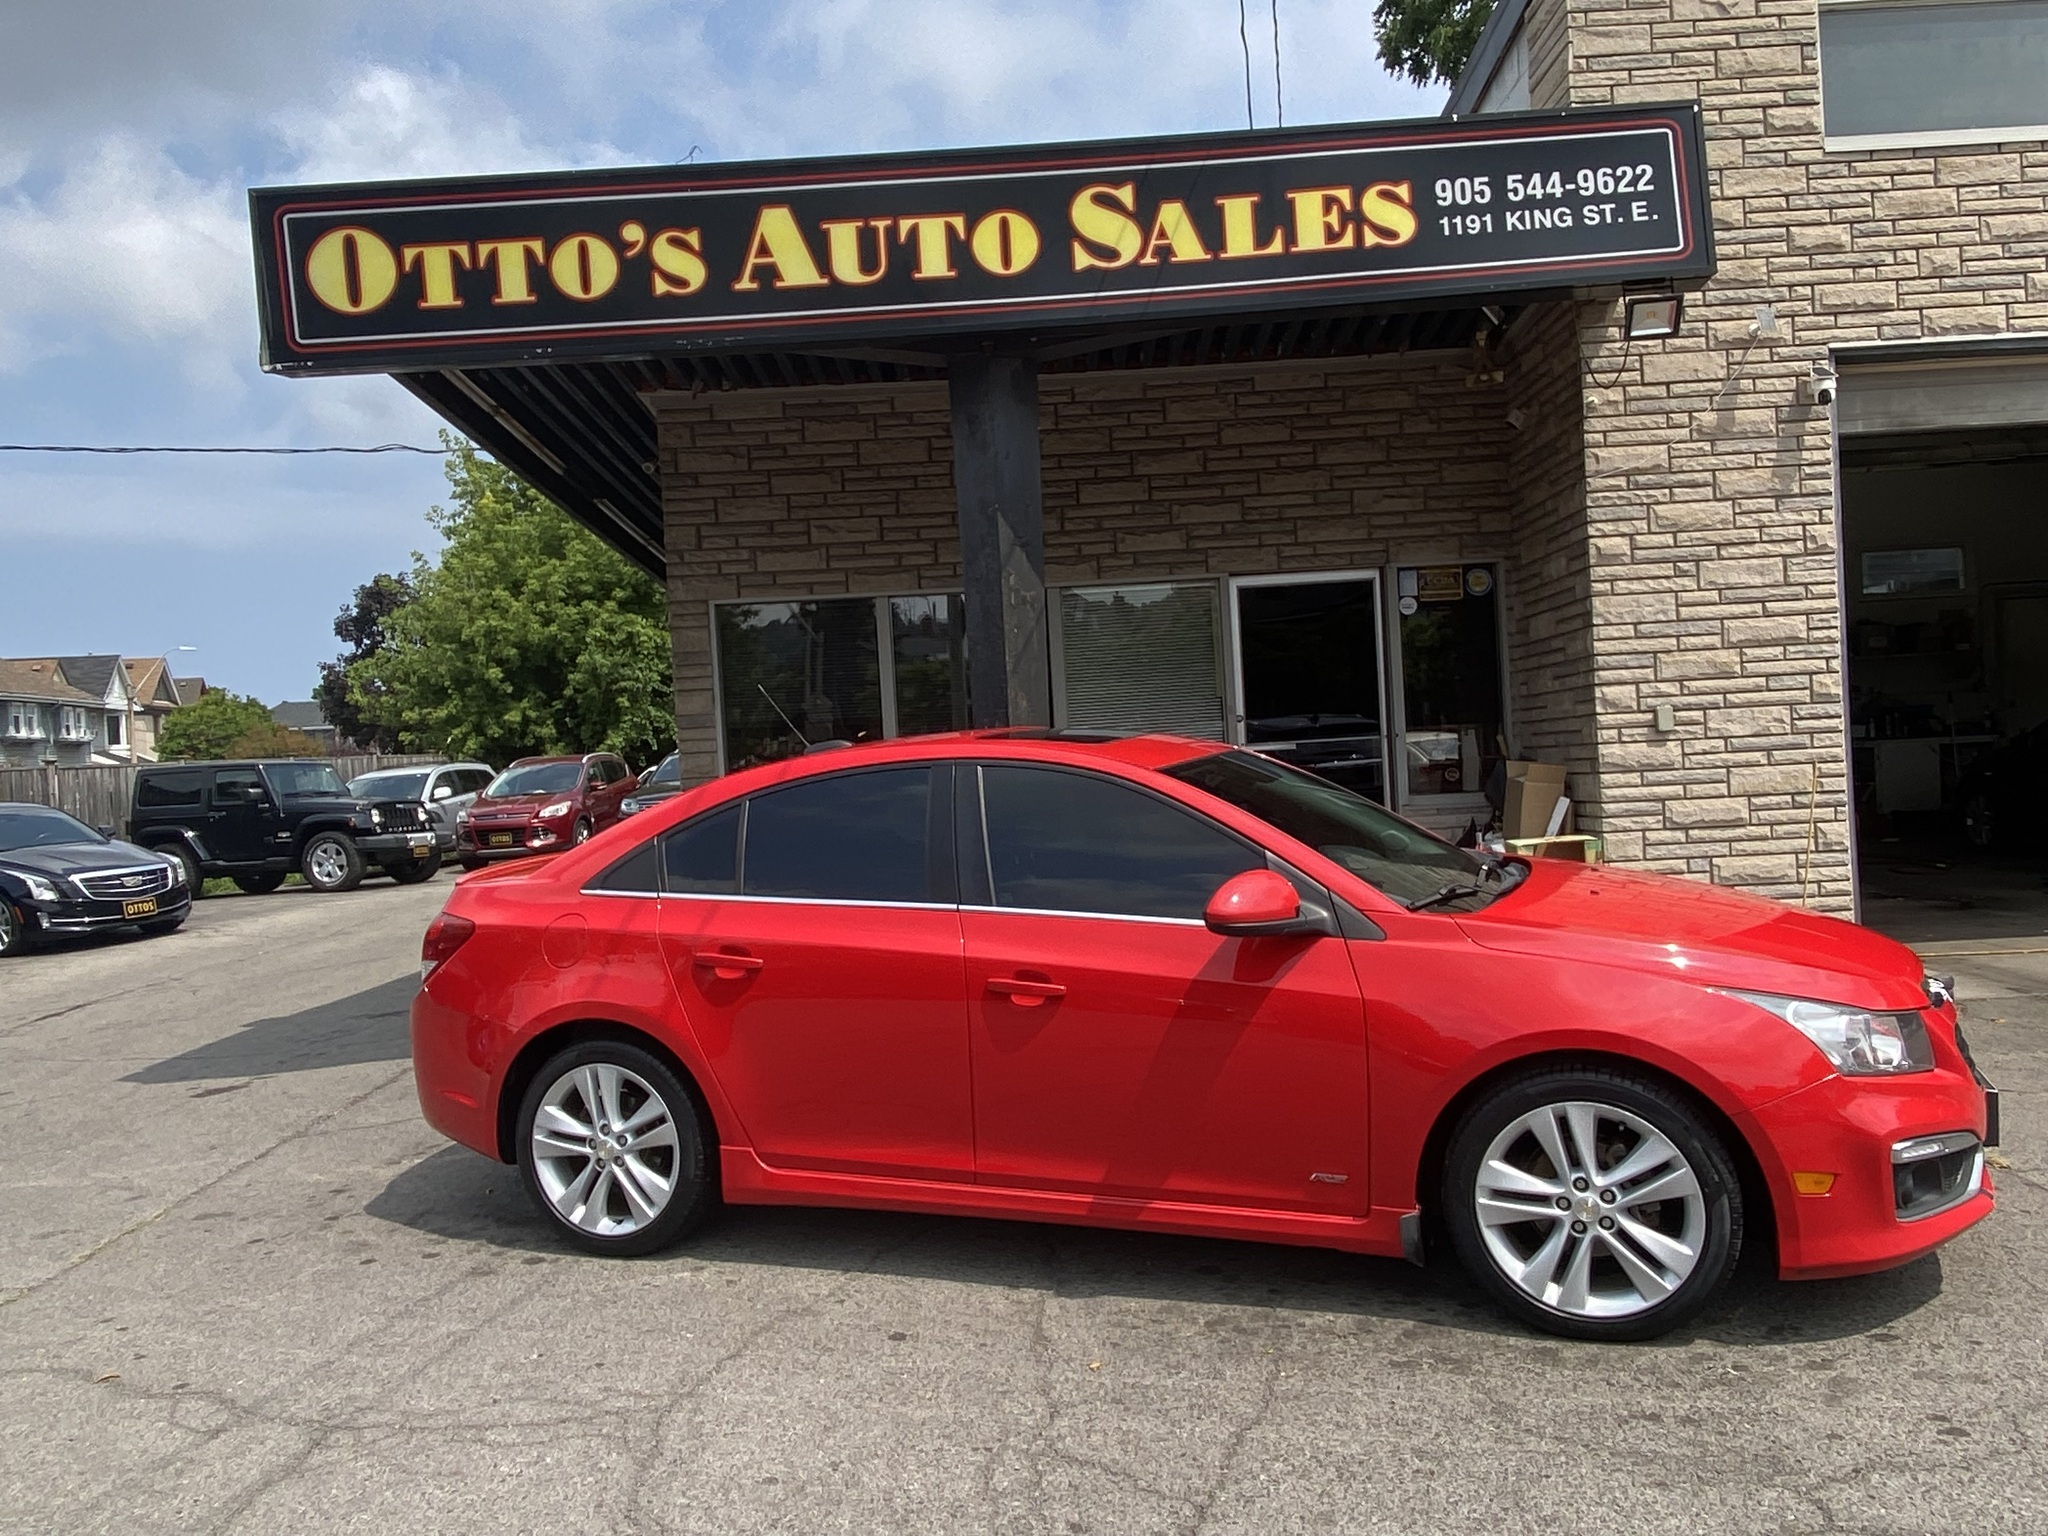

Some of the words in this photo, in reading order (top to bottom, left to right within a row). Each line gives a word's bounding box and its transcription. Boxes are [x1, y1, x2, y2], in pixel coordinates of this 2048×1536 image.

[1434, 176, 1491, 206] 905
[1506, 164, 1655, 201] 544-9622
[1439, 213, 1493, 236] 1191
[1505, 207, 1573, 232] KING
[1583, 203, 1624, 226] ST.
[1631, 201, 1659, 222] E.
[306, 219, 709, 315] OTTO'S
[732, 204, 1041, 291] AUTO
[1068, 180, 1418, 273] SALES
[127, 901, 154, 914] OTTOS
